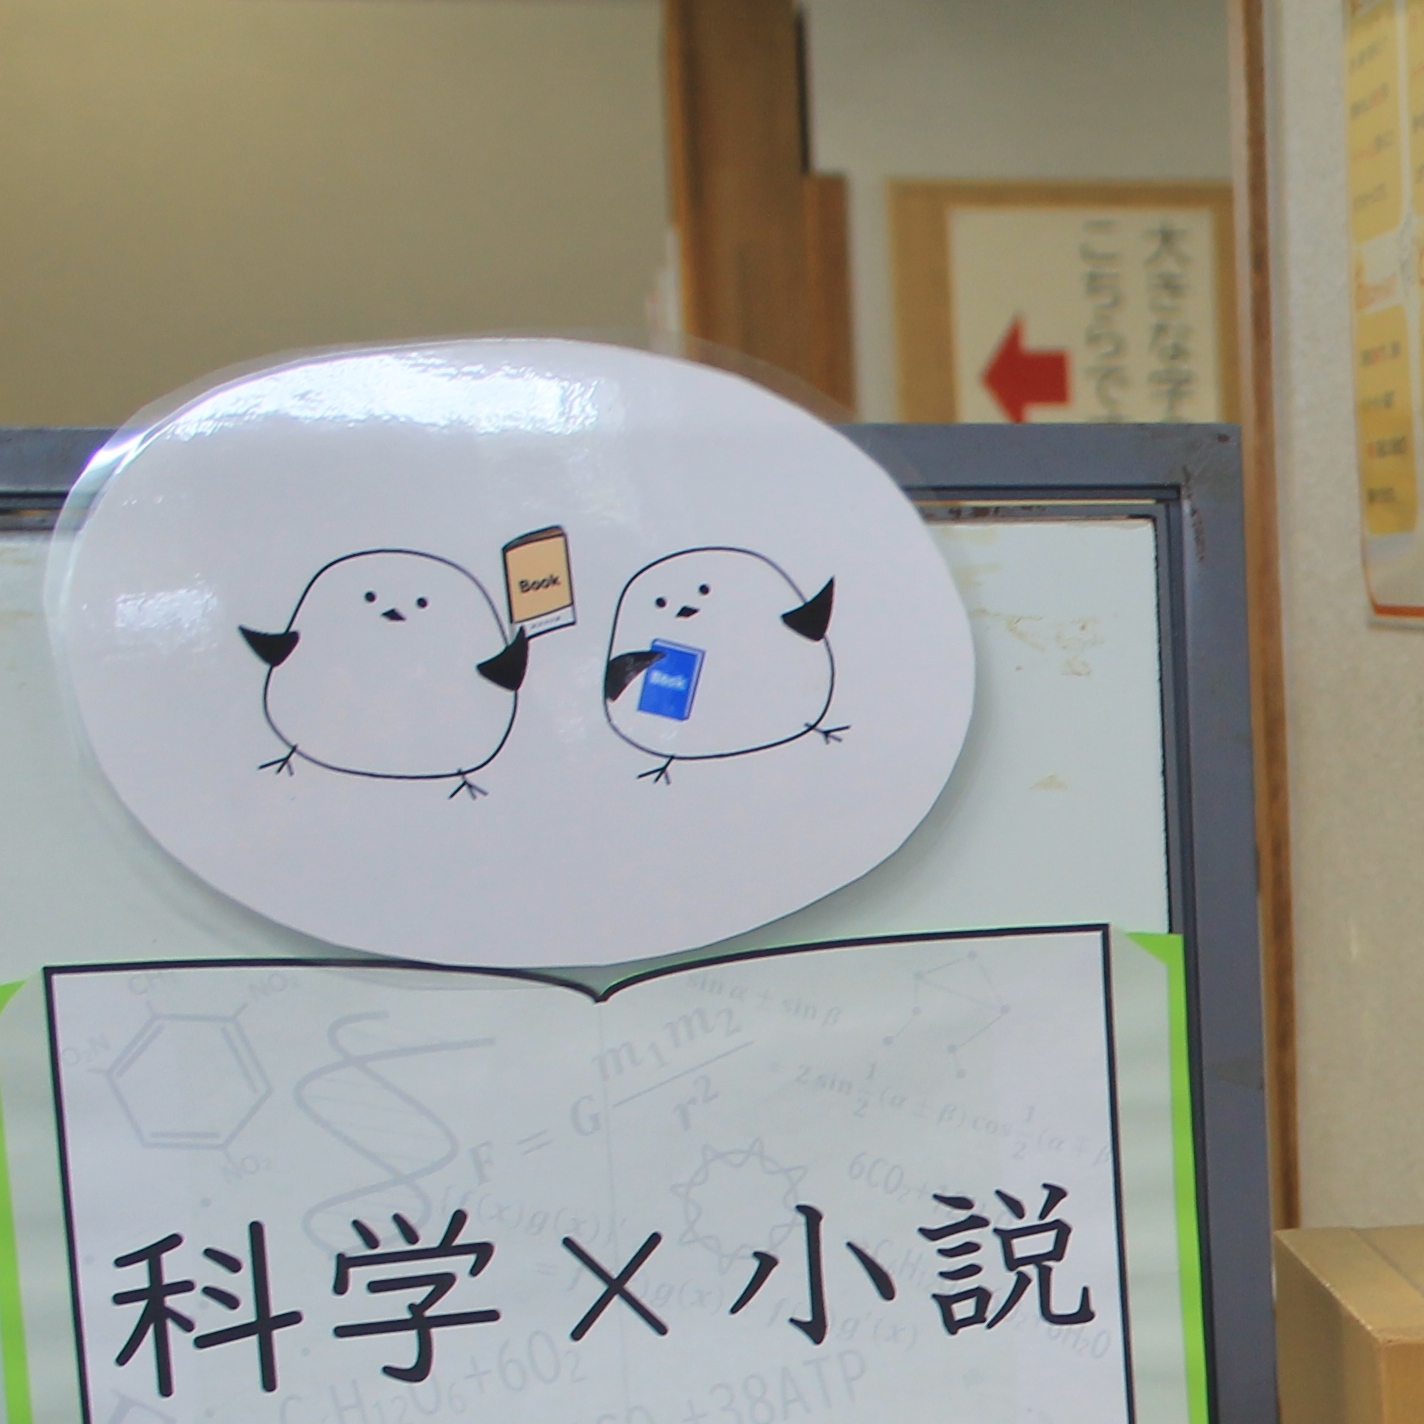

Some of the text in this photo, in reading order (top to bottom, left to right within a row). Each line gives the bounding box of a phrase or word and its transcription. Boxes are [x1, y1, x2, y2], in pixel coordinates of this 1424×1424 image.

[518, 574, 561, 594] Book
[112, 1180, 1096, 1398] 科学×小説
